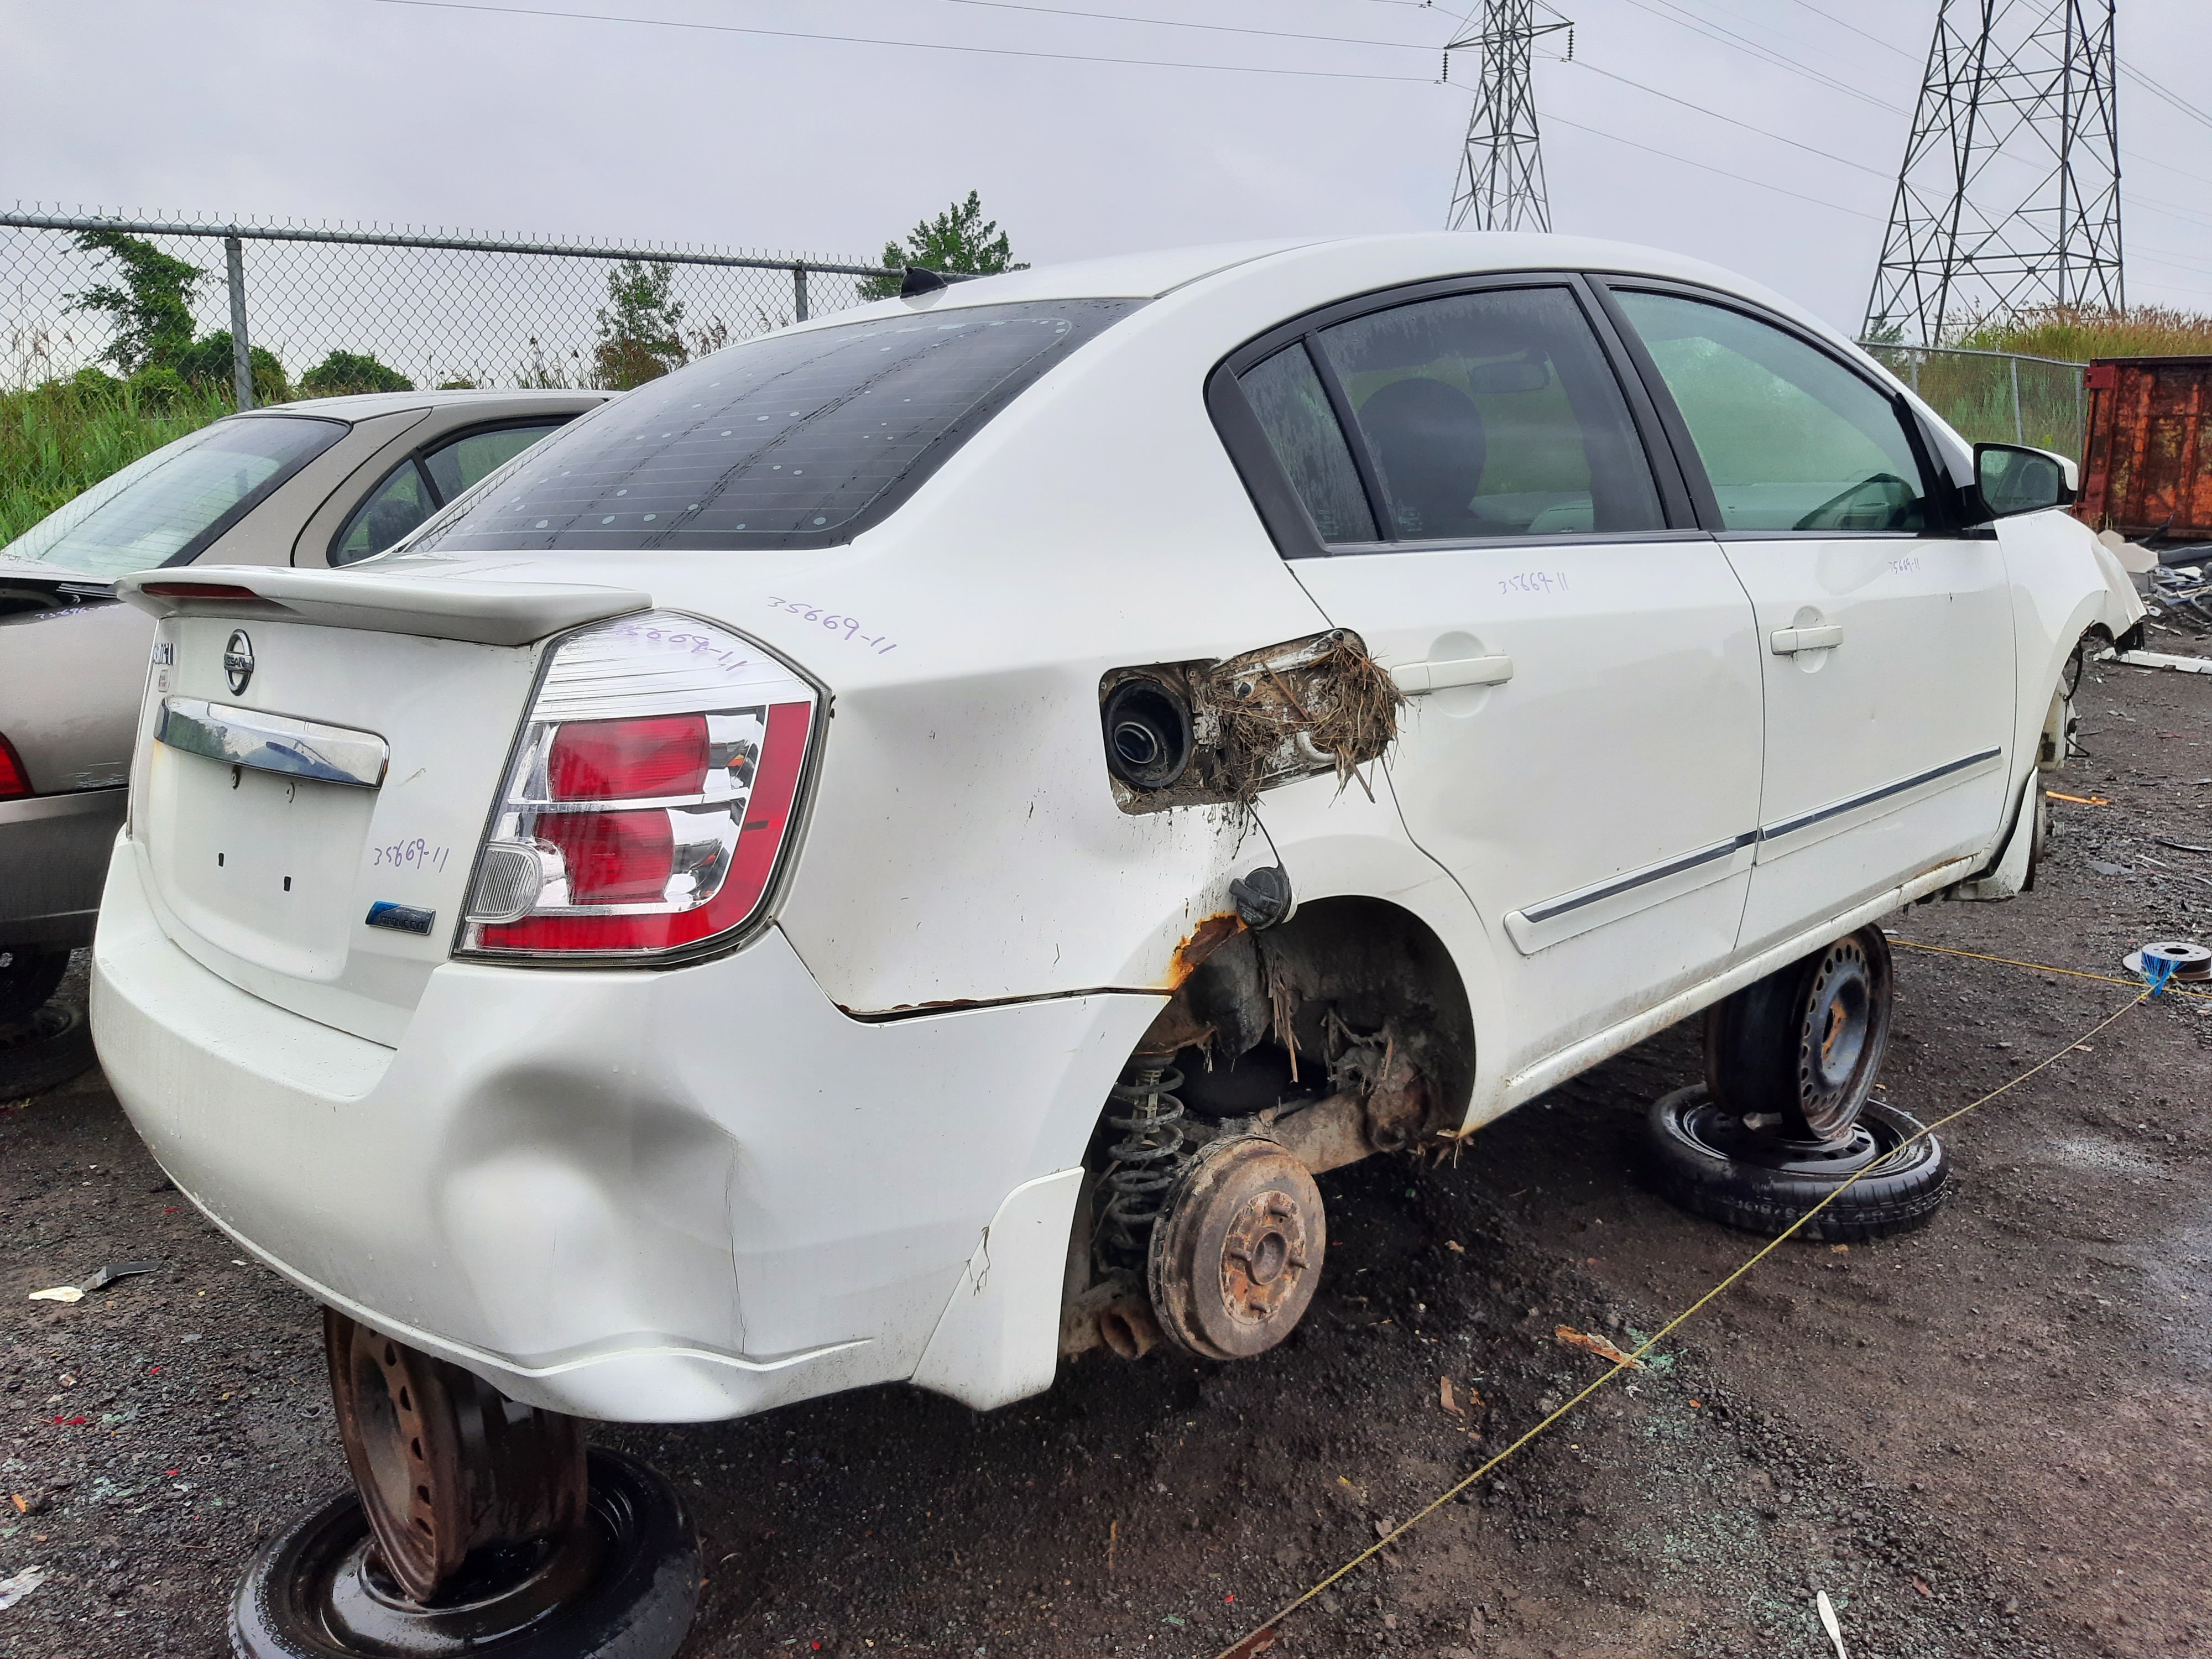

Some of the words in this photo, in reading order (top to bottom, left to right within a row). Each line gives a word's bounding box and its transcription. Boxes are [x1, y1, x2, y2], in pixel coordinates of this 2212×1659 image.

[1498, 571, 1569, 594] 35669-11
[767, 596, 897, 654] 35669-11
[373, 838, 450, 874] 35669-11
[378, 916, 409, 929] XTRONIC
[410, 920, 425, 931] CVT
